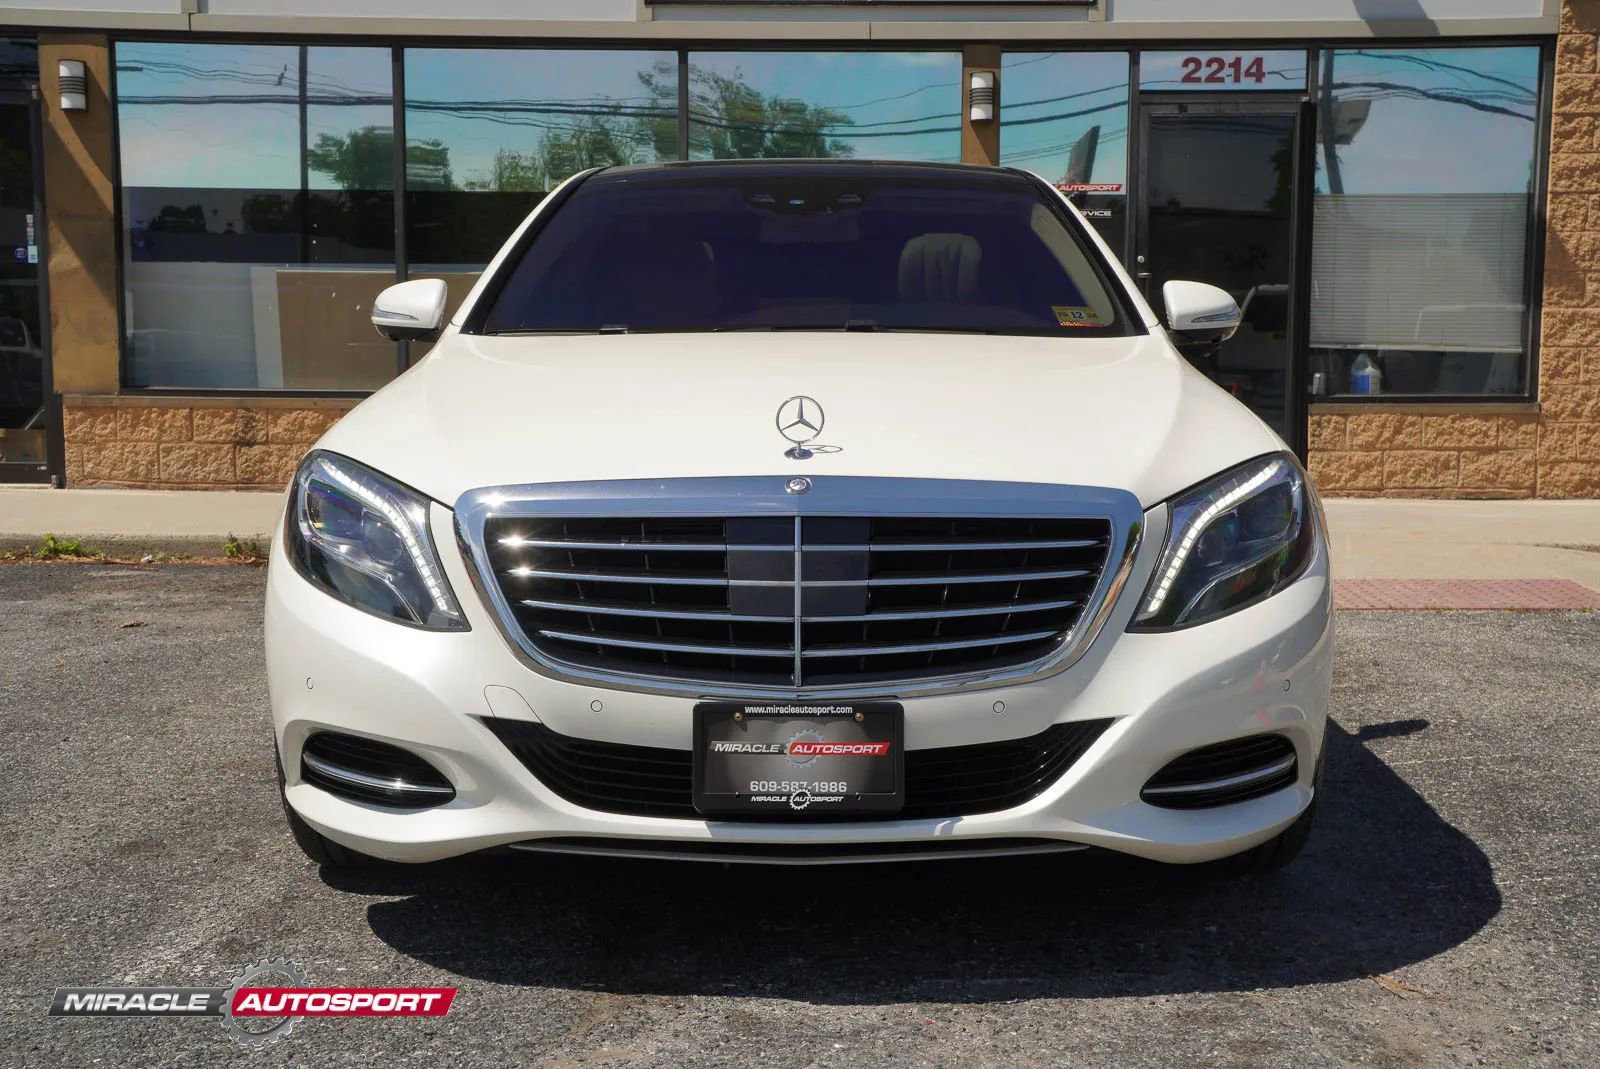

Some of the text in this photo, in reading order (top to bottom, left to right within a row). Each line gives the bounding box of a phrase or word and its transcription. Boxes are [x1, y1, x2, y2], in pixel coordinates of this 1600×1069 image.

[1181, 57, 1265, 83] 2214
[1058, 184, 1120, 192] AUTOSPORT
[744, 705, 853, 715] www.miracleautosport.com
[714, 743, 883, 754] MIRACLE AUTOSPORT
